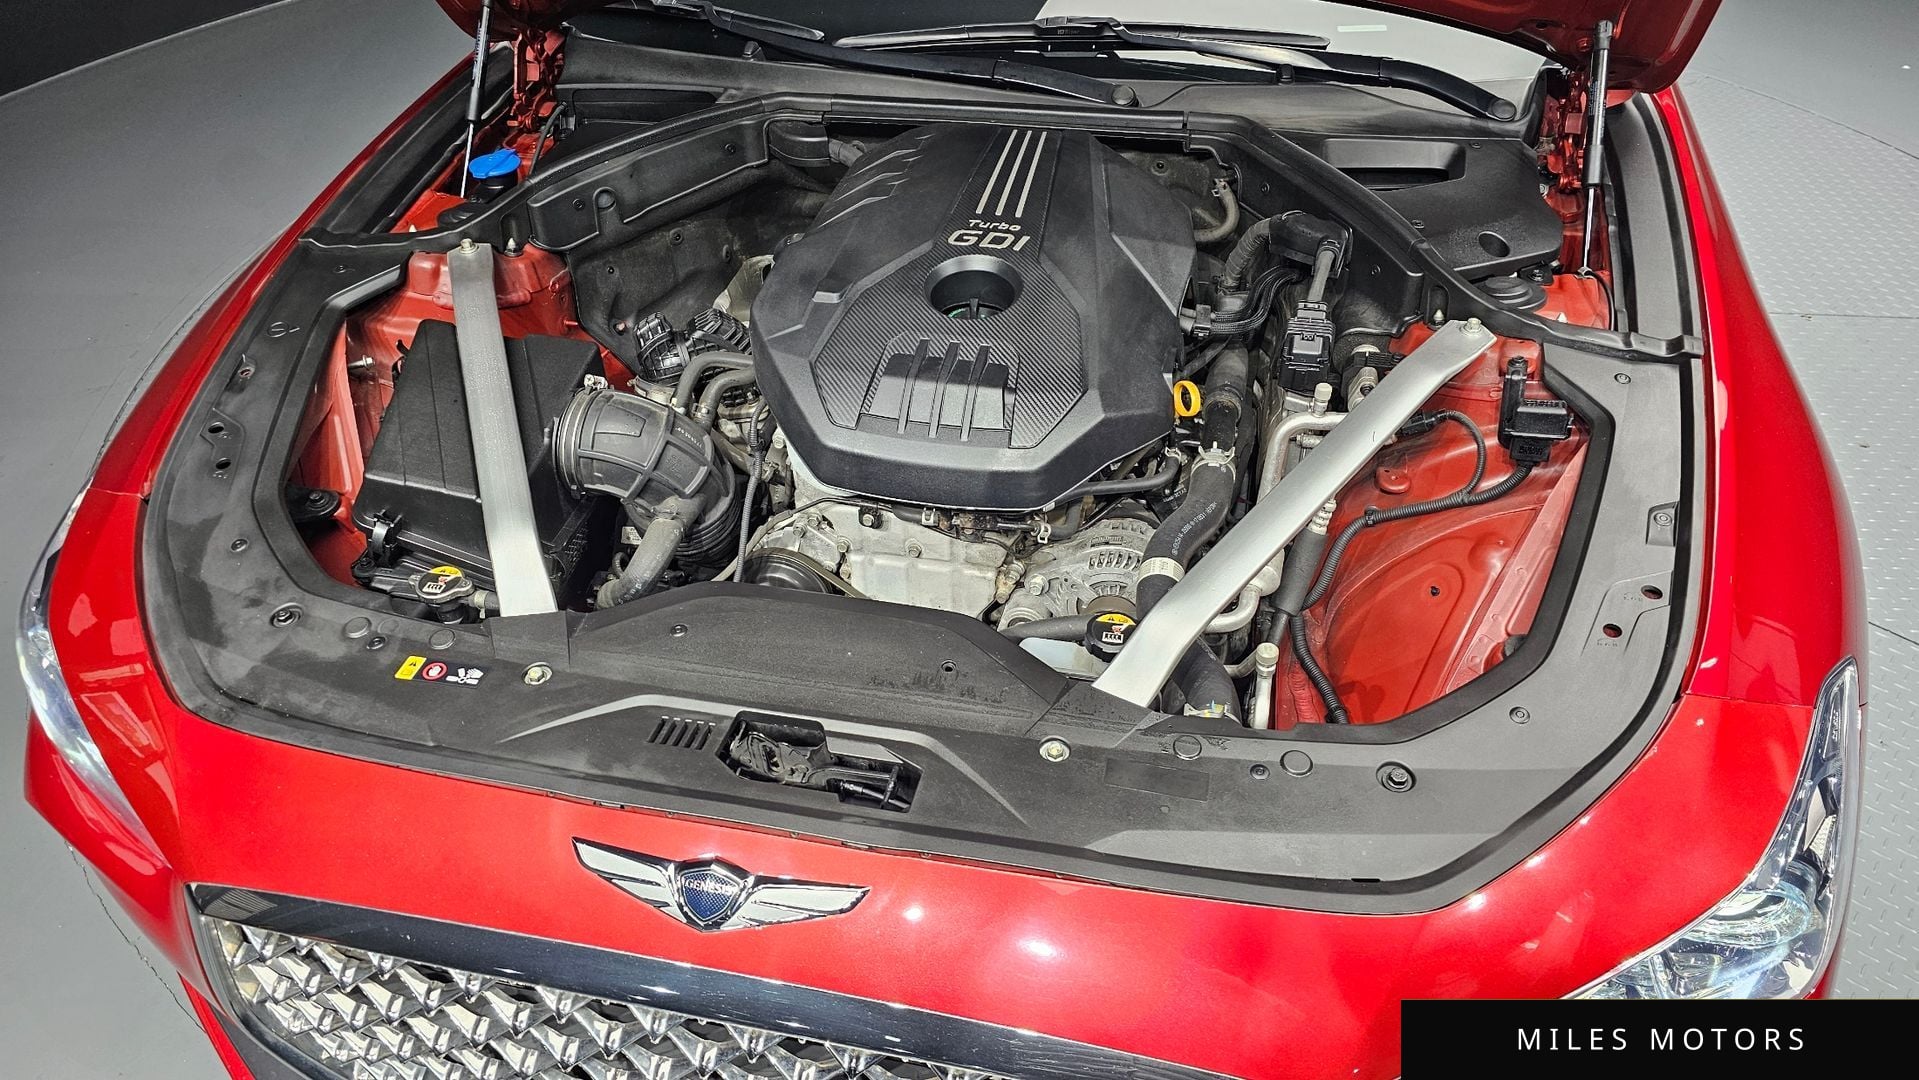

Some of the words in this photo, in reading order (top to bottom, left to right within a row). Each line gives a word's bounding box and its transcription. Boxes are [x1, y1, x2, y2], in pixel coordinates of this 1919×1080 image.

[968, 219, 1022, 231] Turbo
[948, 230, 1031, 251] GDI
[685, 877, 733, 896] GENESIS
